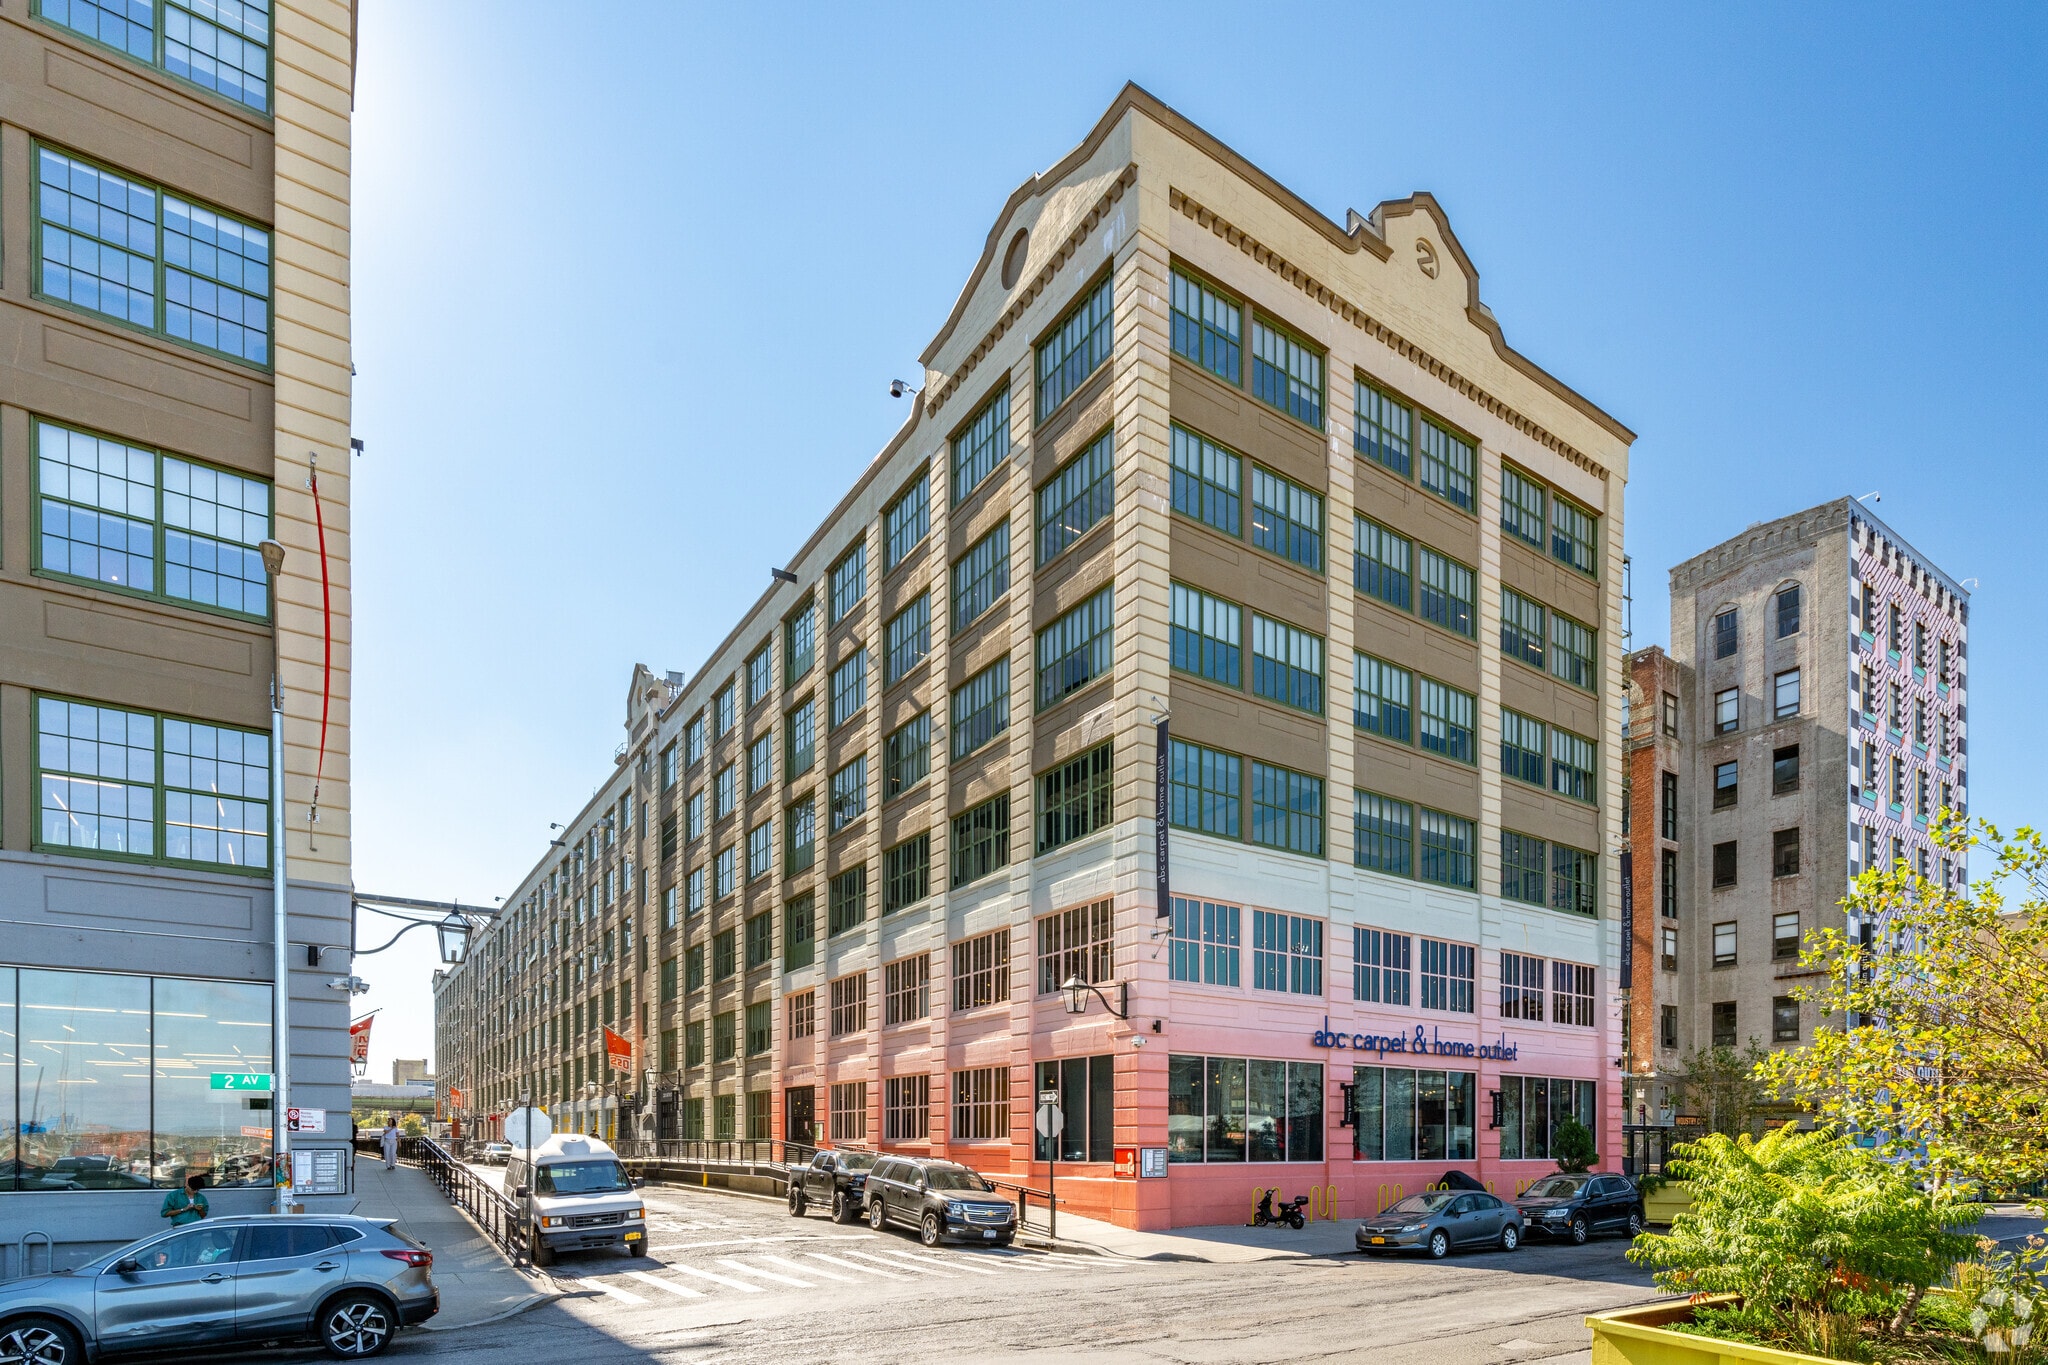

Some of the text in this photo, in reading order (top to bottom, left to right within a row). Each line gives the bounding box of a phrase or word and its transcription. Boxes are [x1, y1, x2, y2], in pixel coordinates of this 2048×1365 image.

[1416, 241, 1435, 280] 2
[1157, 786, 1165, 816] home
[1156, 818, 1165, 827] &
[1158, 828, 1167, 862] carpet
[1158, 865, 1166, 883] abc
[1622, 876, 1631, 897] outlet
[1623, 898, 1631, 919] home
[1622, 952, 1631, 966] abc
[1314, 1015, 1518, 1061] abc carpet & home outlet
[224, 1075, 259, 1089] 2 AV
[1127, 1152, 1133, 1174] 2
